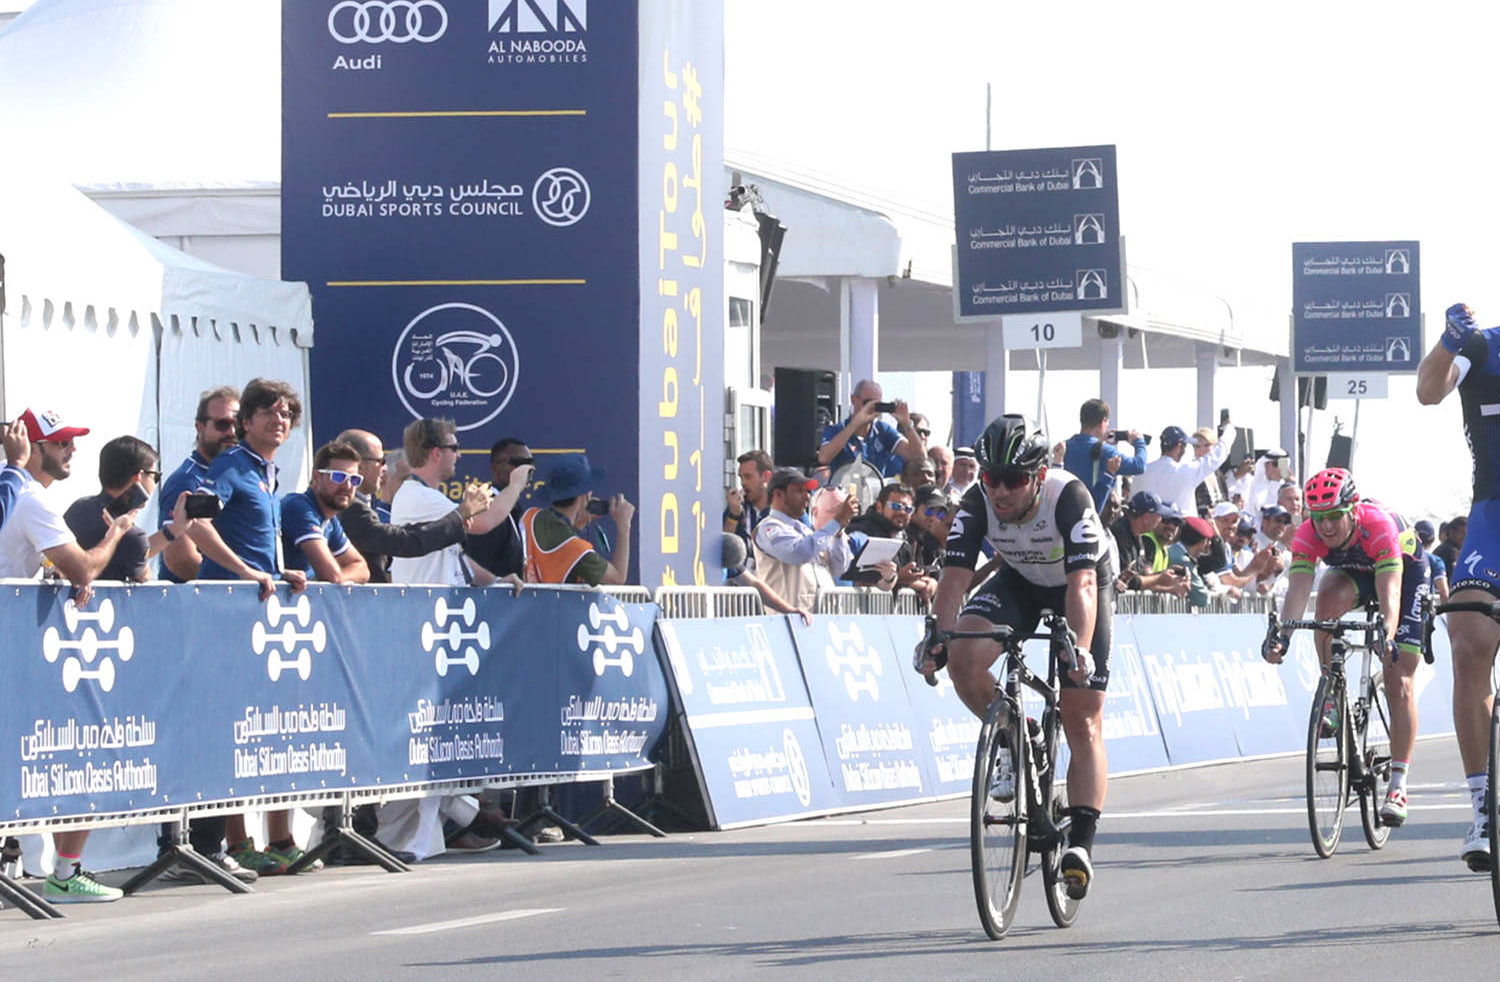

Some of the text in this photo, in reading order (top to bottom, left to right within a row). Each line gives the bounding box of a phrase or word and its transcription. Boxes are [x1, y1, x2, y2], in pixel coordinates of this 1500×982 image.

[488, 40, 587, 53] AL NABOODA
[332, 55, 382, 70] Audi
[488, 54, 587, 63] AUTOMOBILES
[403, 183, 443, 201] دبي
[450, 180, 523, 201] مجلس
[968, 181, 1069, 194] Commercial Bank of Dubai
[322, 202, 523, 217] DUBAI SPORTS COUNCIL
[970, 236, 1072, 249] Commercial Bank of Dubai
[972, 292, 1073, 305] Commercial Bank of Dubai
[1031, 323, 1055, 341] 10
[1348, 380, 1367, 394] 25
[1450, 579, 1491, 591] atexco
[408, 732, 504, 766] Dubai Silicon Oasis Authority
[234, 742, 346, 778] Dubai Silicon Oasis Authority
[21, 758, 157, 798] Dubai Silicon Oasis Authority
